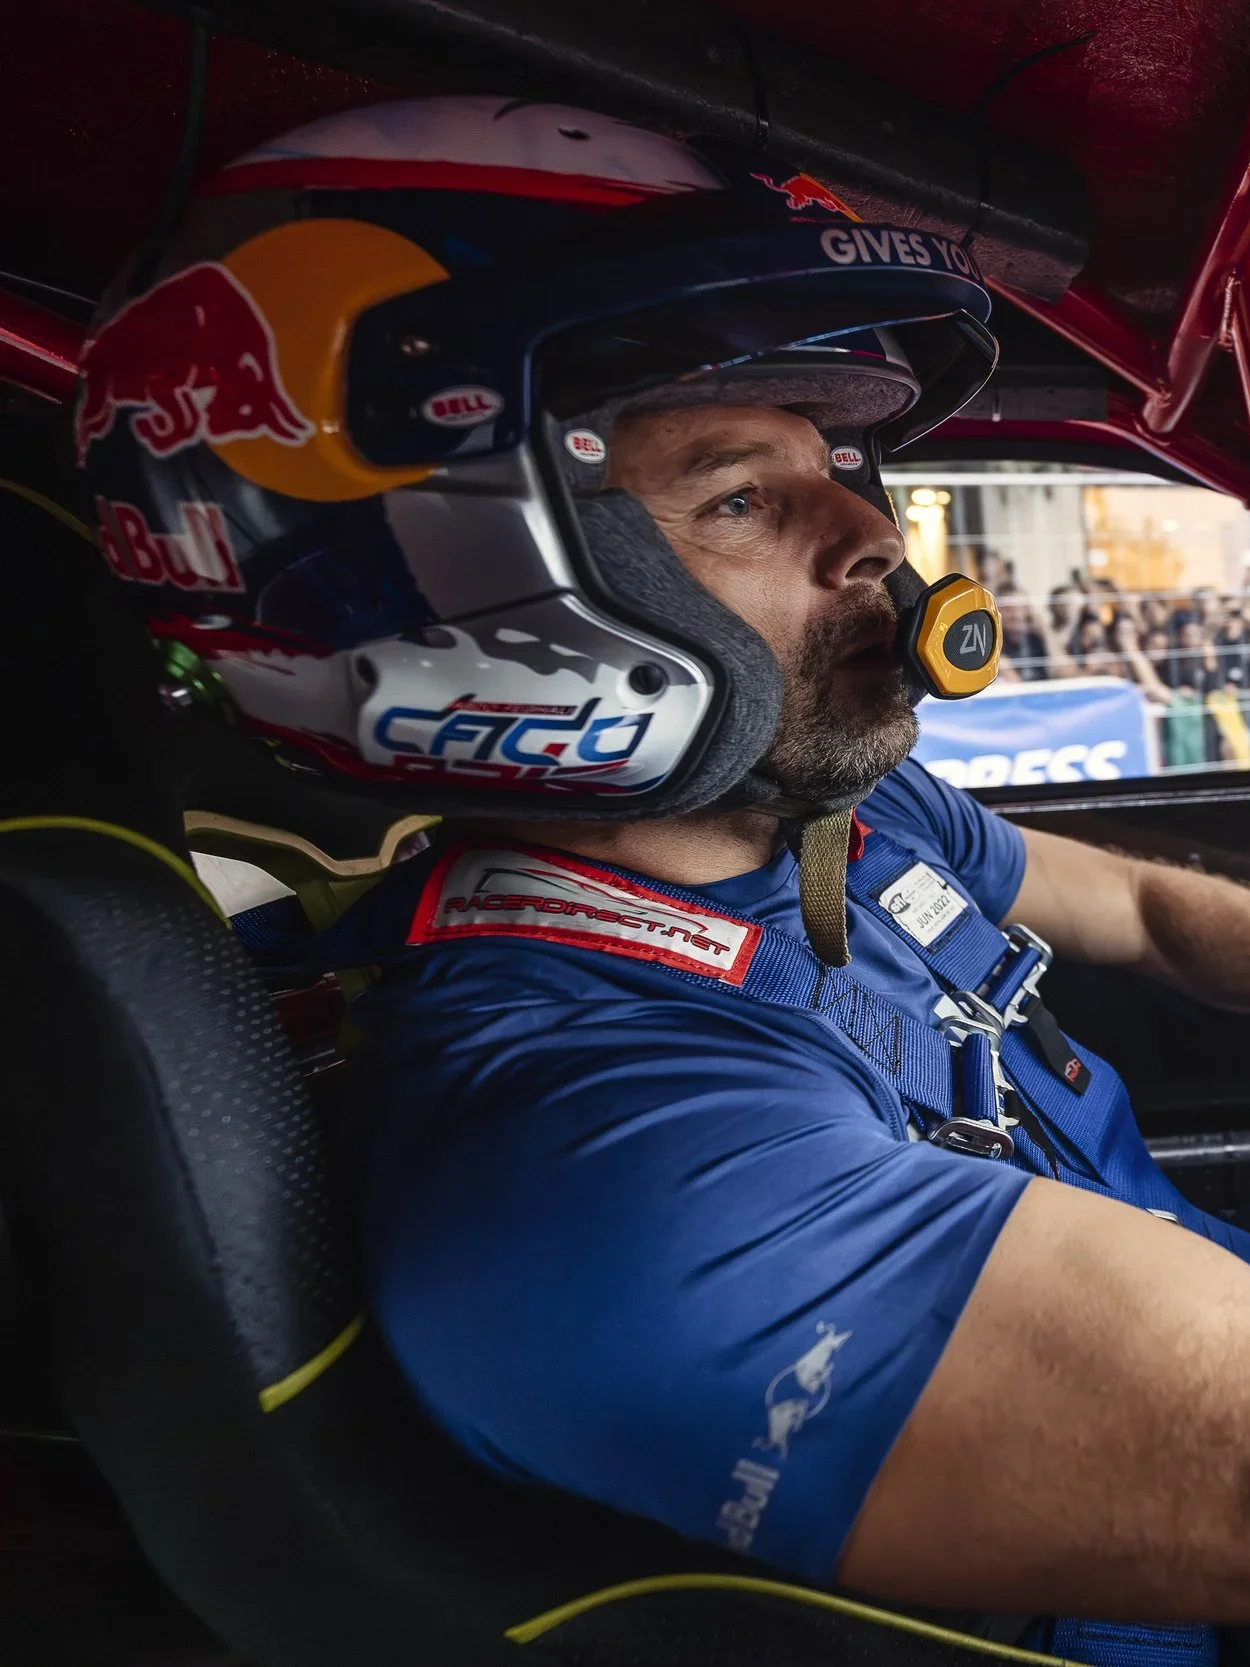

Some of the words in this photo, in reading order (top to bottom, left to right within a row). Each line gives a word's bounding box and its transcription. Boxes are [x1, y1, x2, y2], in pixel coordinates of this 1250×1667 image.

[820, 227, 932, 267] GIVES
[431, 395, 492, 418] BELL
[572, 435, 601, 454] BELL
[834, 452, 861, 463] BELL
[960, 623, 986, 657] ZN
[916, 910, 934, 928] JUN
